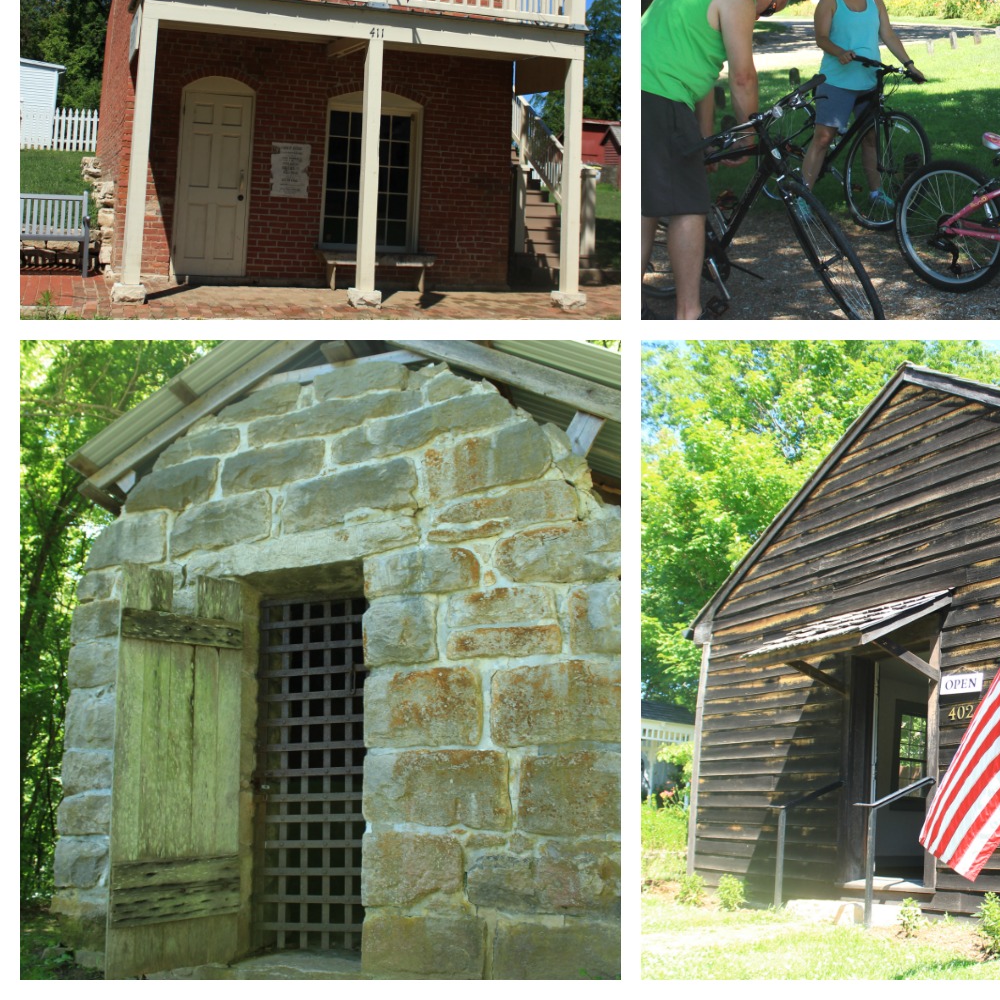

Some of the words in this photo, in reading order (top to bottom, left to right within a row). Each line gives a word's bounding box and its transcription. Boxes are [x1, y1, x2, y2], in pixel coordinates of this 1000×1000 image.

[369, 27, 385, 39] 411
[944, 677, 978, 691] OPEN
[948, 704, 974, 721] 402
